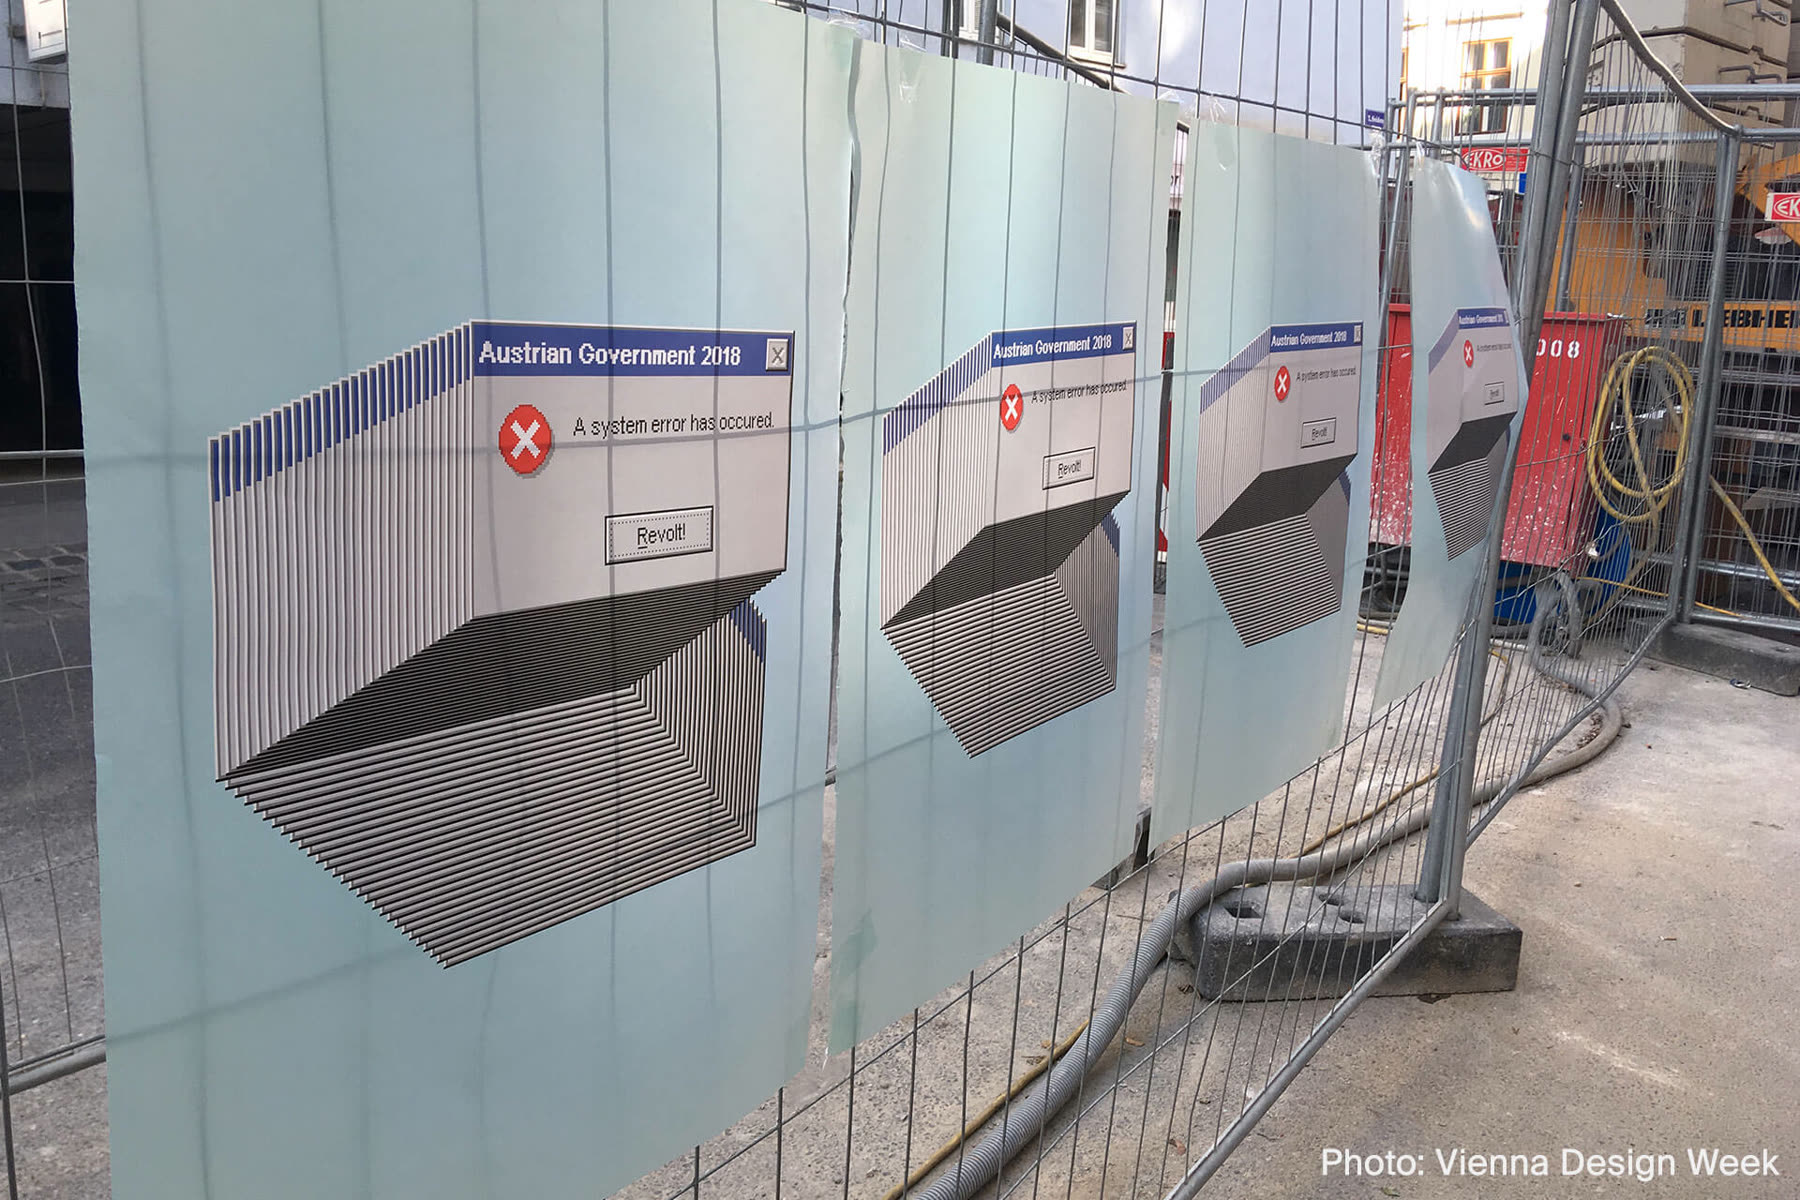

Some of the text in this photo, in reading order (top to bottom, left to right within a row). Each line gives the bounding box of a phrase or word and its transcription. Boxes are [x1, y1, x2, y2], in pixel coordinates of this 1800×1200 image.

[1464, 151, 1506, 168] EKRO
[993, 335, 1112, 359] Austrian Government 2018
[1271, 334, 1299, 346] Austrian
[1300, 332, 1333, 345] Government
[478, 340, 741, 366] Austrian Government 2018
[1031, 390, 1039, 404] A
[1040, 388, 1066, 404] system
[1067, 385, 1085, 399] error
[1086, 383, 1100, 396] has
[573, 411, 775, 439] A system error has occured.
[637, 523, 686, 550] Revolt!
